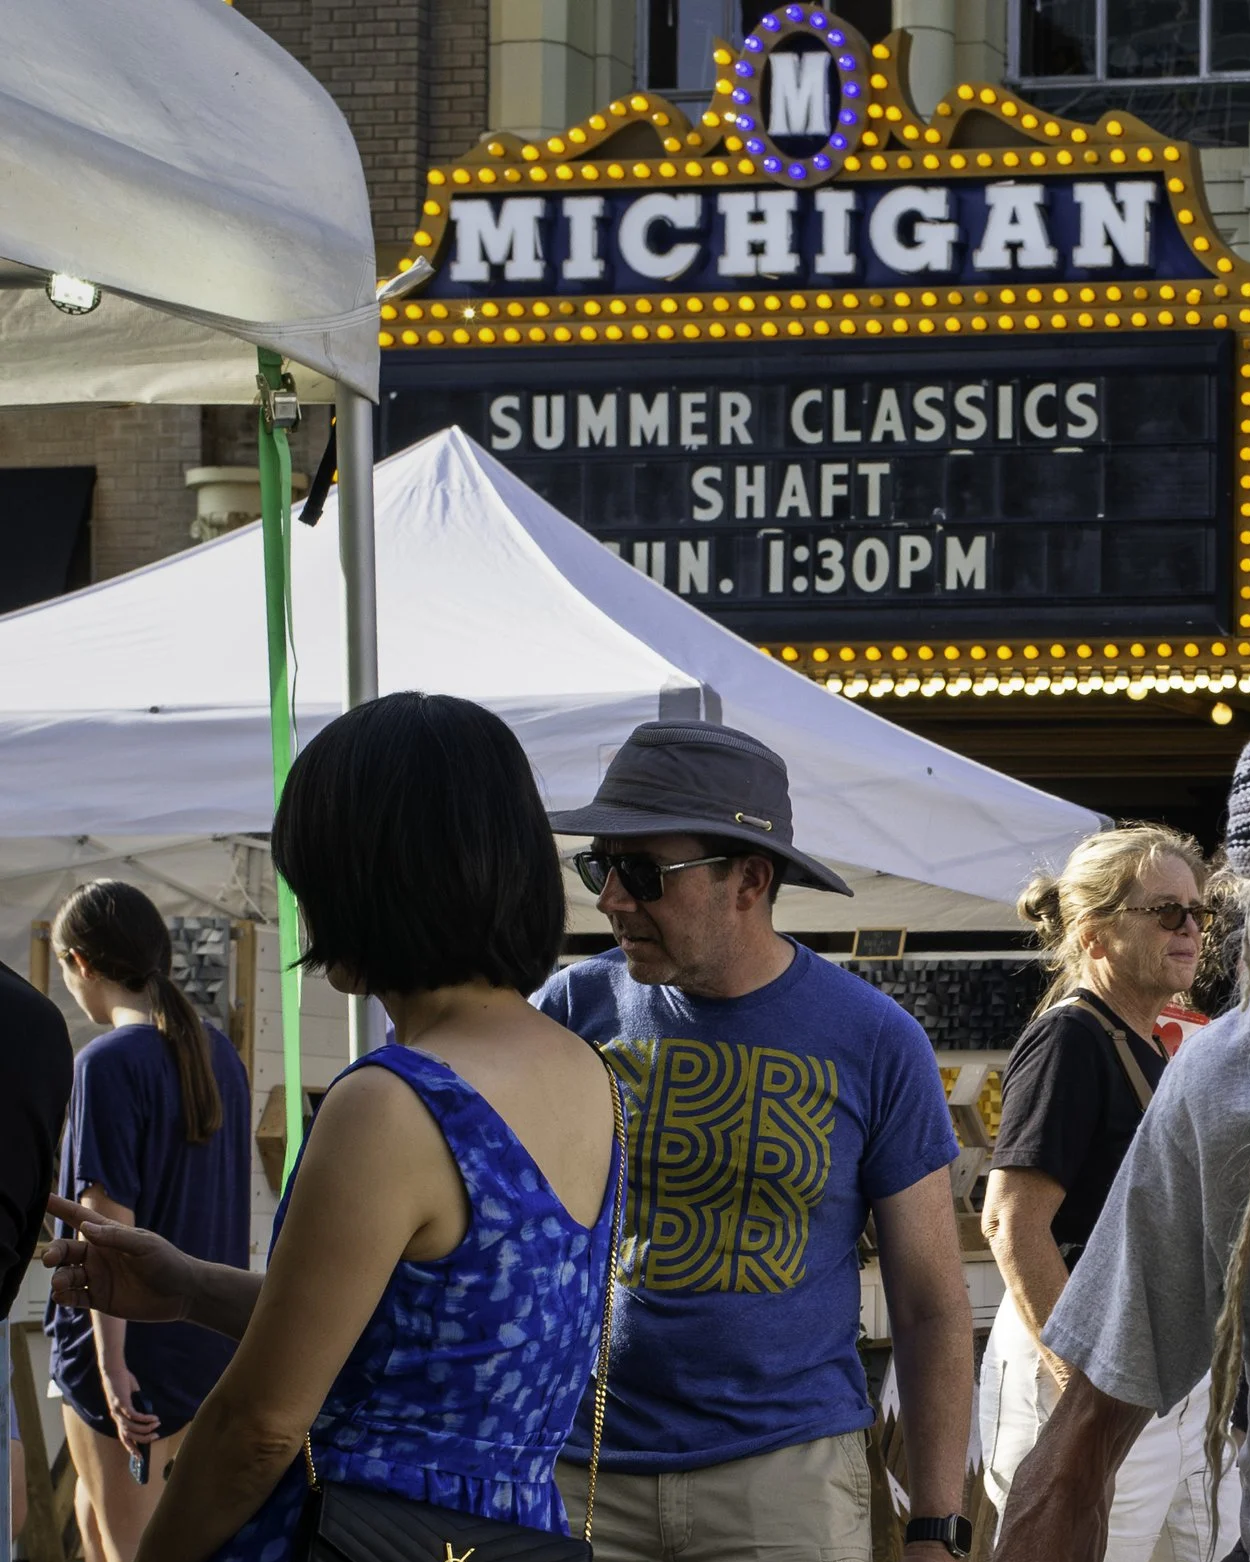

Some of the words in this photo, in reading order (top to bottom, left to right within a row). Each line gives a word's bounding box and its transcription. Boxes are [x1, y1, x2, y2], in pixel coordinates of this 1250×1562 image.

[768, 52, 830, 136] M
[450, 181, 1156, 283] MICHIGAN
[490, 392, 752, 451] SUMMER
[791, 382, 1099, 444] CLASSICS
[691, 462, 890, 522] SHAFT
[601, 540, 734, 594] UN.
[769, 535, 987, 593] 1:30PM
